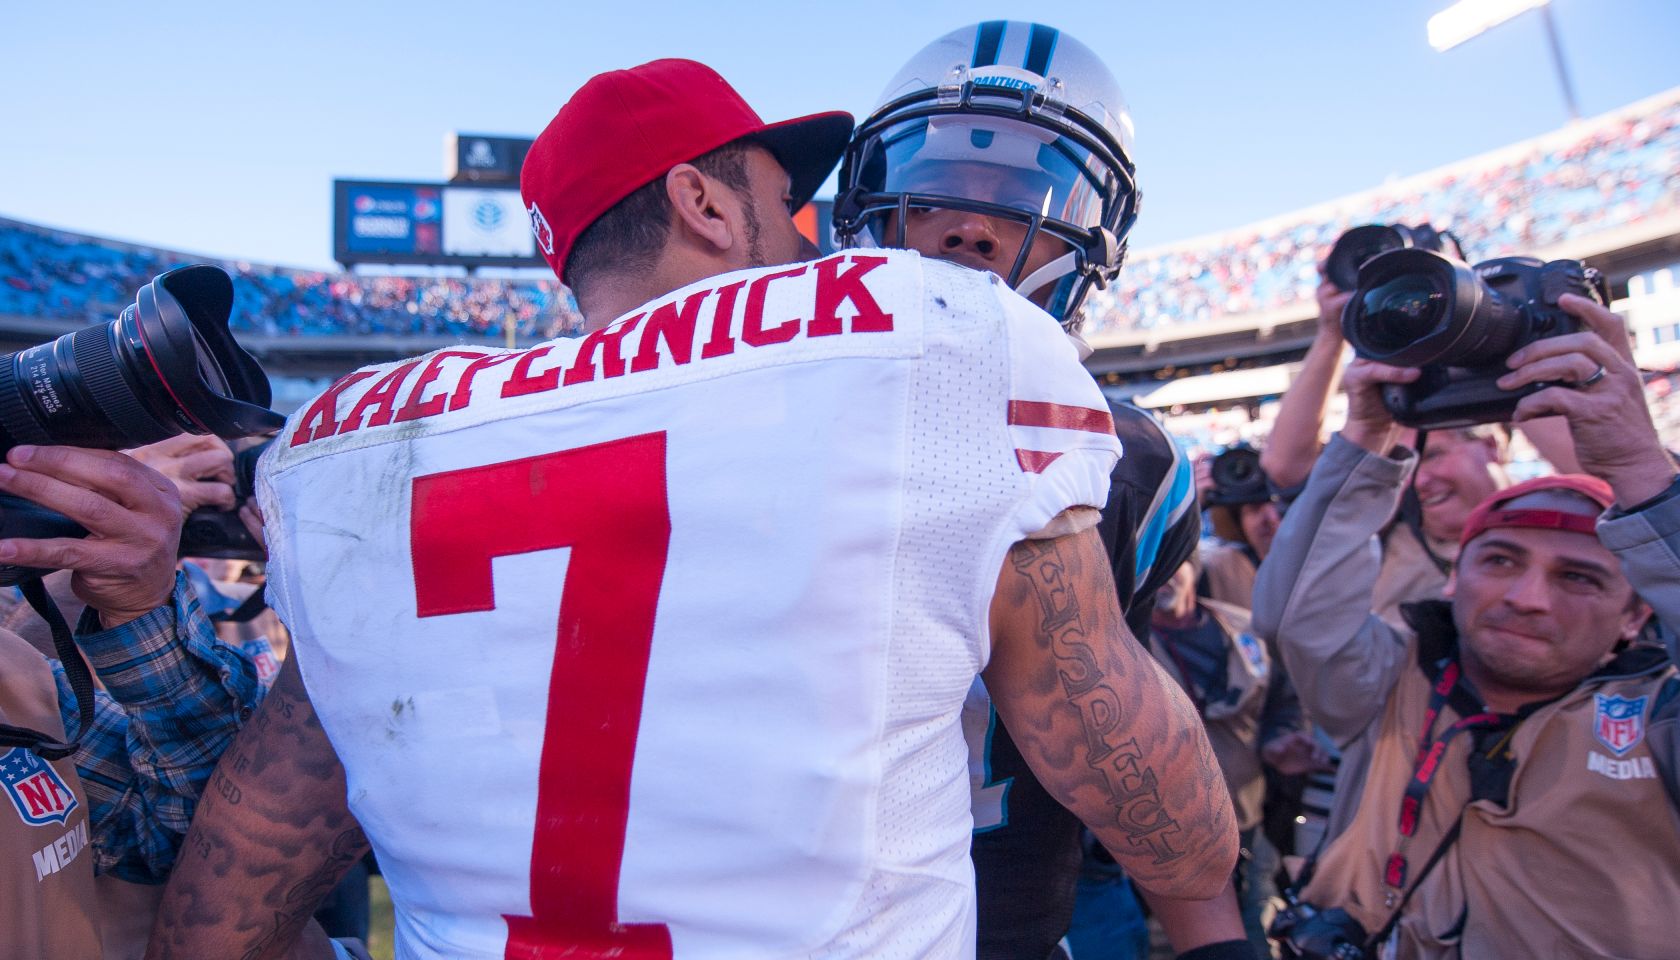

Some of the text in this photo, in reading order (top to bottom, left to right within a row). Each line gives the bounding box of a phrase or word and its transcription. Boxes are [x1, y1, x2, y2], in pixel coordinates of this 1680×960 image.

[974, 76, 1037, 91] PANTHERS
[290, 255, 895, 448] KAEPERNICK
[410, 430, 672, 960] 7
[1587, 750, 1657, 780] MEDIA
[16, 771, 73, 816] NF
[31, 818, 89, 883] MEDIA
